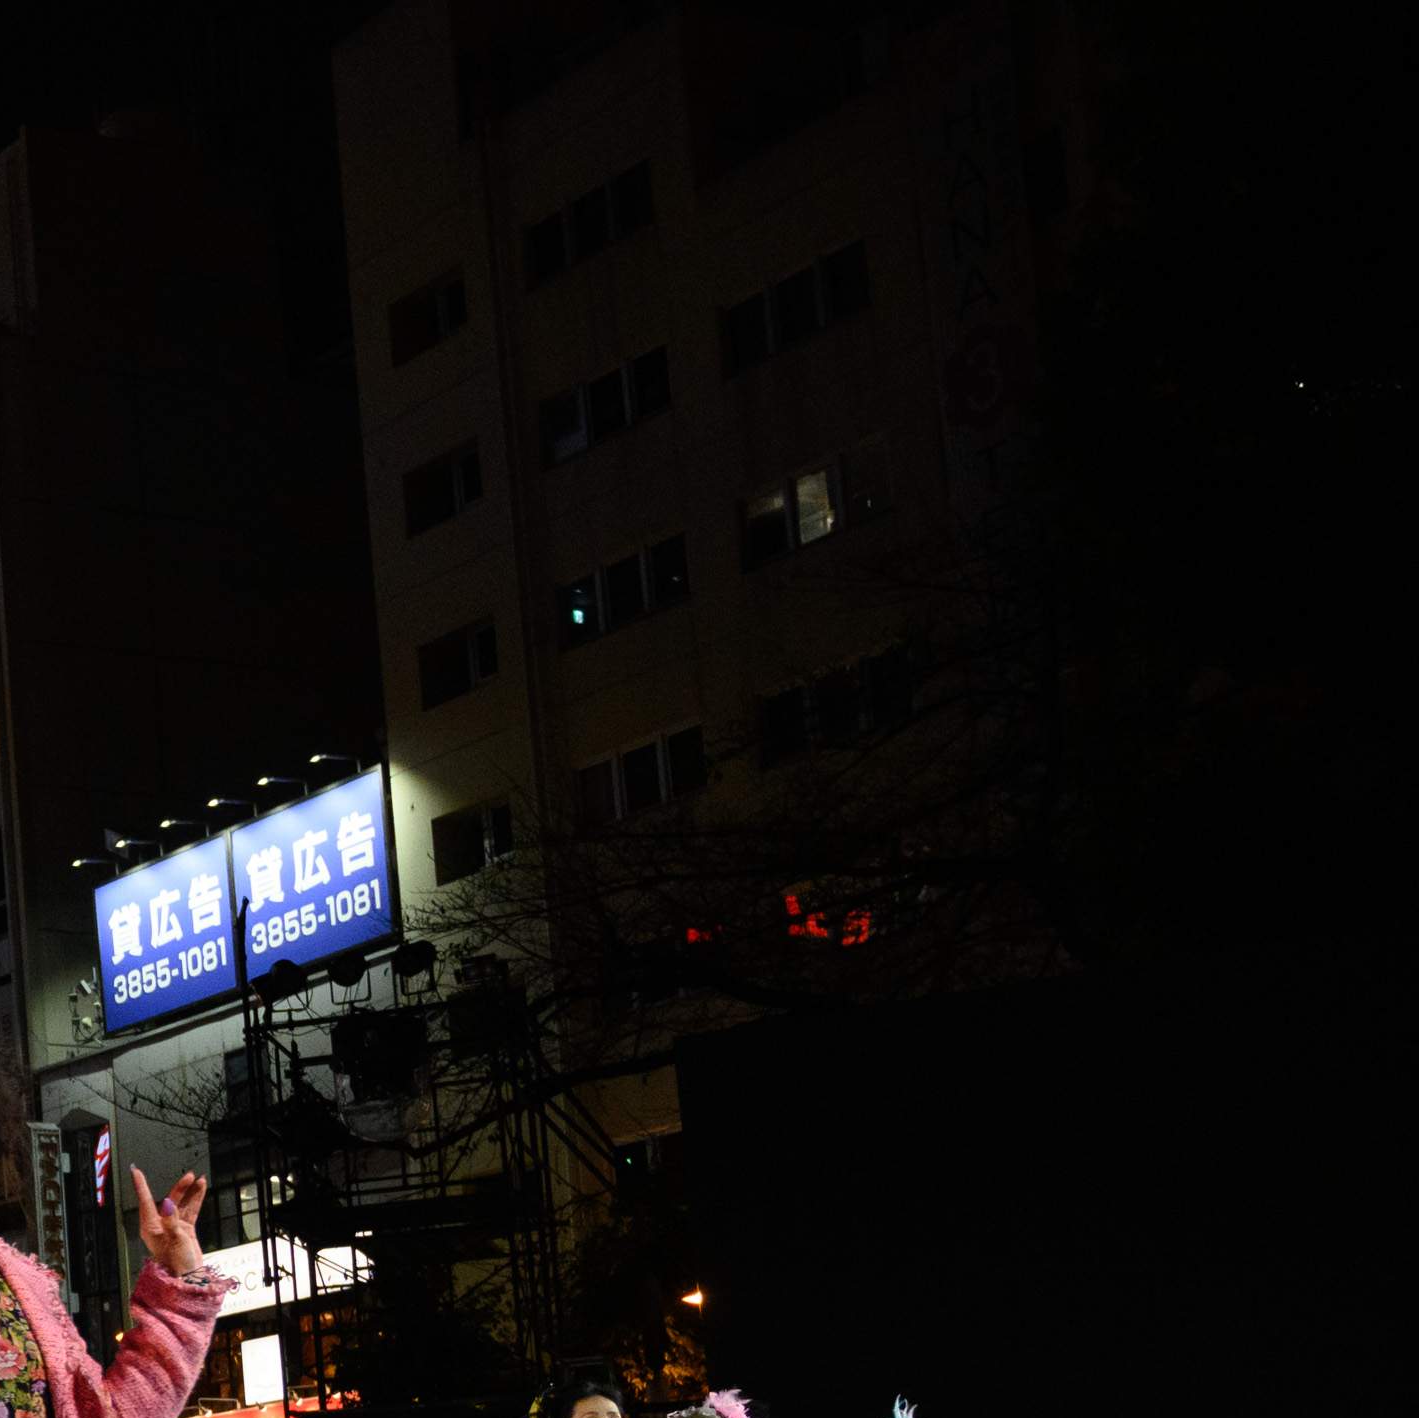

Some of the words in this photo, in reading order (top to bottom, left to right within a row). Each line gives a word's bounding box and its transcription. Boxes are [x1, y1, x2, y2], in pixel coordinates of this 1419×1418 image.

[245, 811, 377, 913] 貸広告
[108, 873, 224, 965] 貸広告
[250, 878, 382, 955] 3855-1081
[113, 936, 229, 1004] 3855-1081
